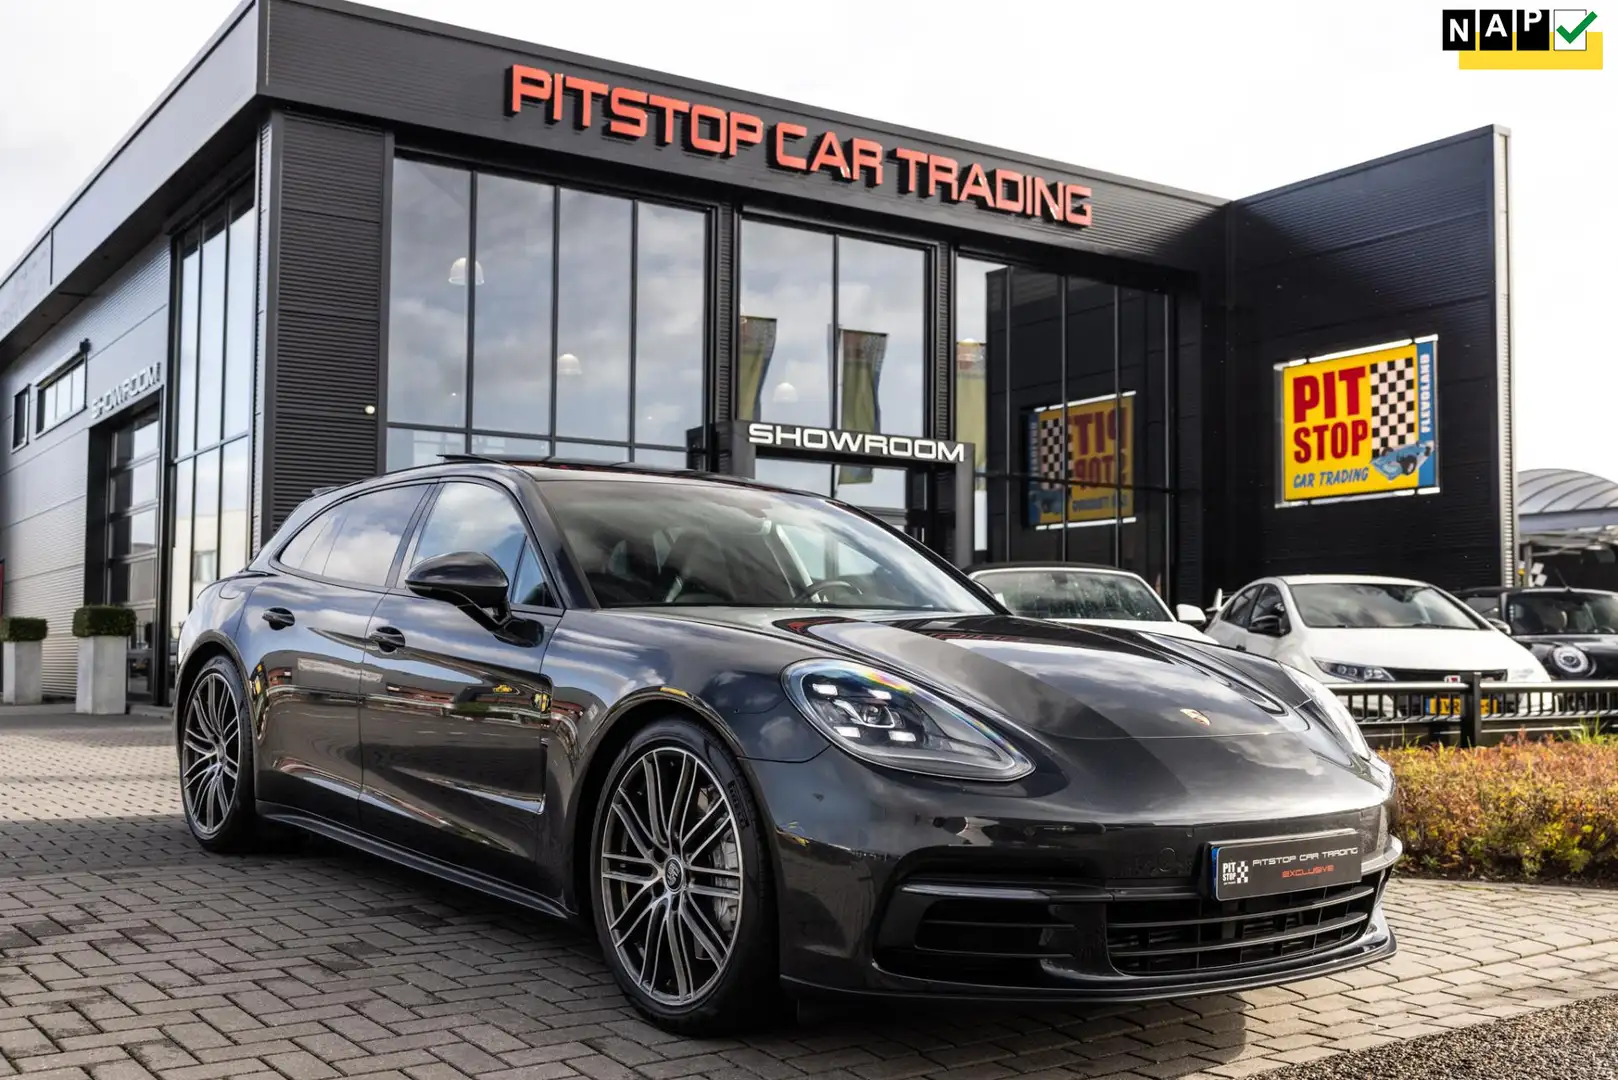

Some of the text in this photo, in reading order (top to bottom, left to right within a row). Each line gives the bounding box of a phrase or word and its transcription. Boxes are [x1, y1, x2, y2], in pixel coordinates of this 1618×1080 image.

[510, 64, 1092, 227] PITSTOP CAR TRADING
[1292, 366, 1366, 424] PIT
[1419, 353, 1431, 433] FLEVOLAND
[749, 423, 965, 462] SHOWROOM
[1293, 419, 1369, 464] STOP
[1293, 466, 1369, 488] CAR TRADING
[1222, 861, 1237, 873] PIT
[1252, 846, 1359, 867] PITSTOP CAR TRADING
[1281, 864, 1336, 878] EXCLUSIVE
[1222, 872, 1237, 881] STOP
